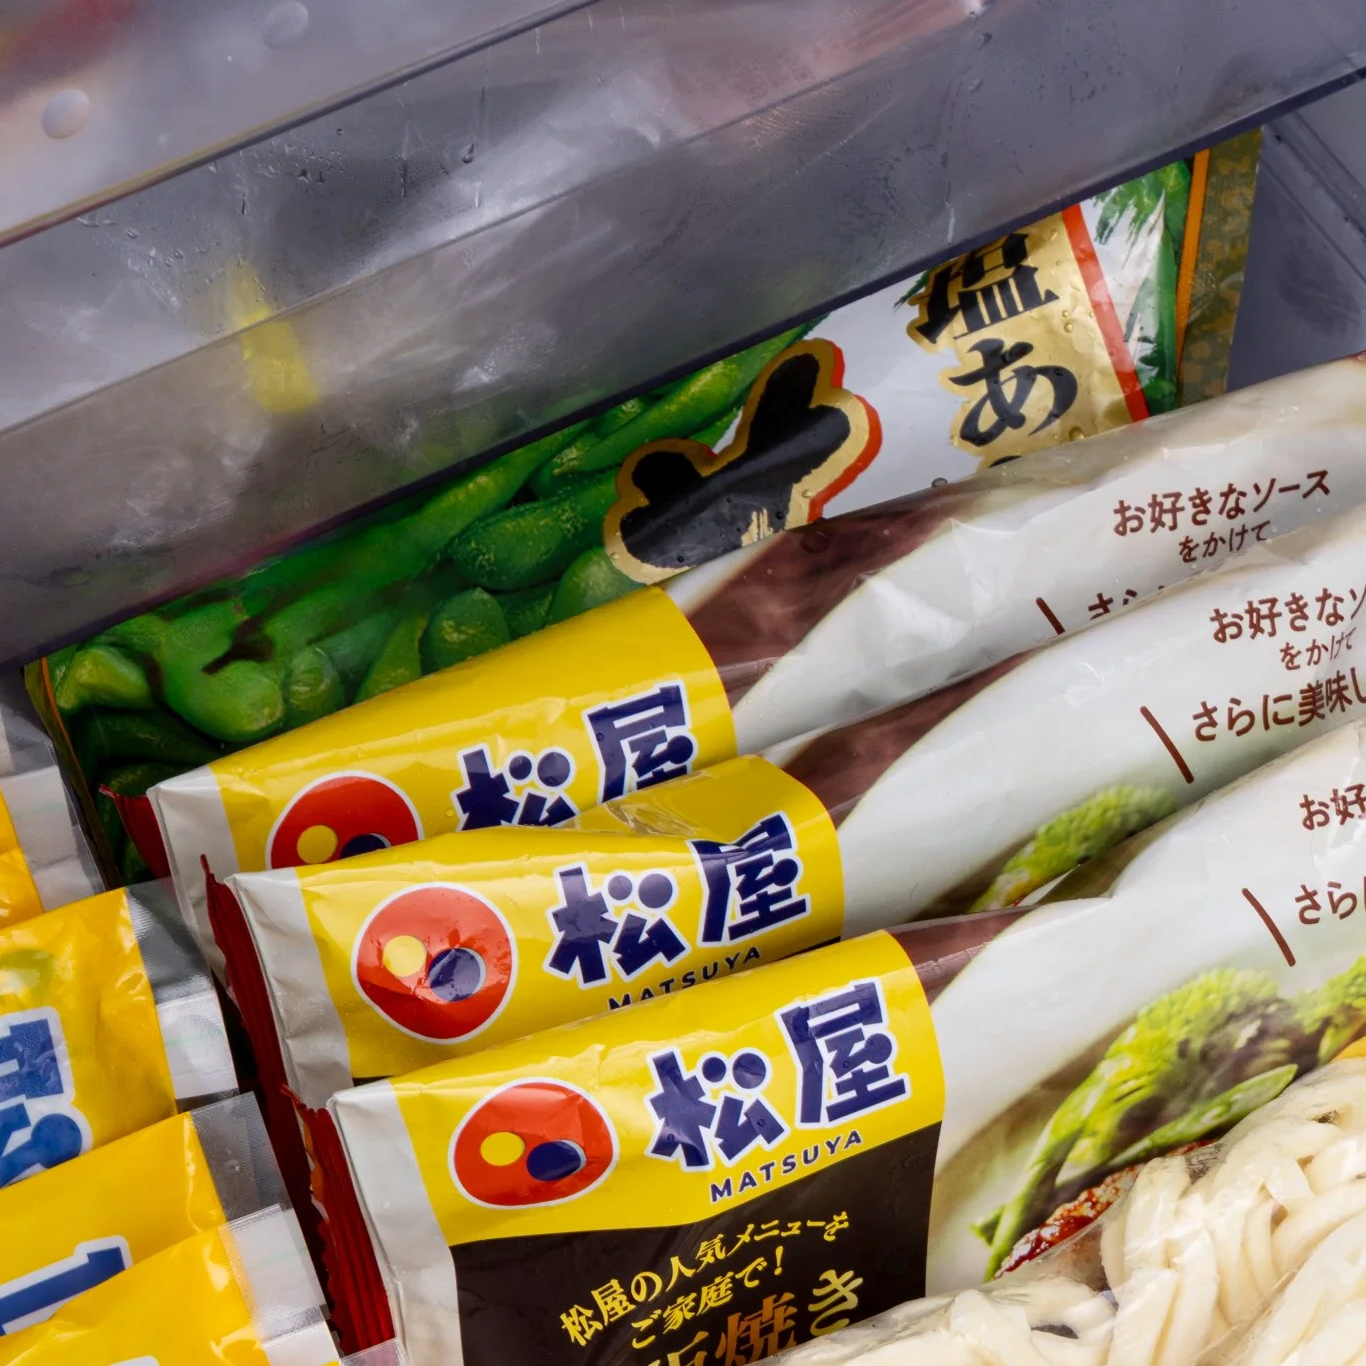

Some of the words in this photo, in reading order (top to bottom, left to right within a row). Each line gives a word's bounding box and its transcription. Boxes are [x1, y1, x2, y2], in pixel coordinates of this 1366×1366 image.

[1112, 469, 1332, 537] お好きなソース
[1177, 520, 1272, 564] をかけて
[1279, 626, 1358, 671] をかけて
[547, 812, 810, 987] 松屋
[607, 946, 761, 1012] MATSUYA
[649, 981, 909, 1171] 松屋
[709, 1129, 864, 1203] MATSUYA
[558, 1210, 850, 1347] 松屋の人気メニューを
[630, 1246, 785, 1349] ご家庭で！
